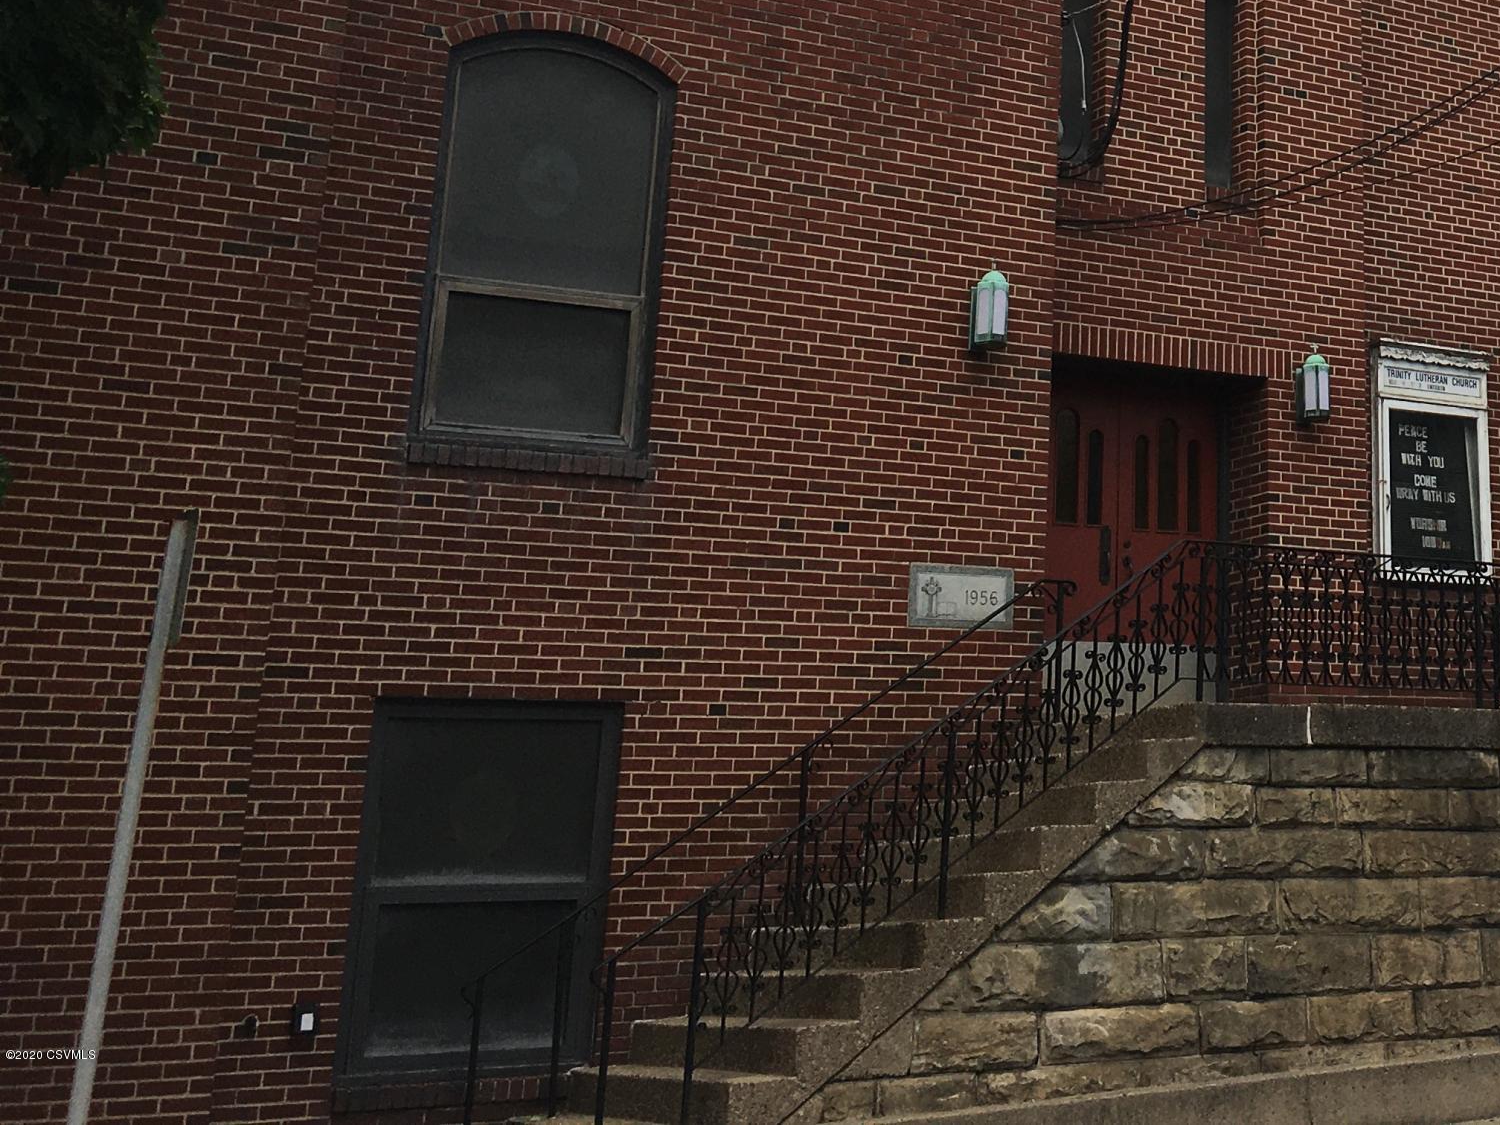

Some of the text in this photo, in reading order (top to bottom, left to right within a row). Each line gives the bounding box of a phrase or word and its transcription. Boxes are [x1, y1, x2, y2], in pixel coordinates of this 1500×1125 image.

[1387, 368, 1412, 380] TRINITY
[1415, 371, 1448, 385] LUTHERAN
[1452, 377, 1478, 389] CHURCH
[1398, 424, 1428, 438] PEACE
[1415, 440, 1428, 453] BE
[1401, 452, 1445, 469] WITH YOU
[1413, 474, 1437, 488] COME
[1422, 488, 1443, 503] WITH
[1443, 491, 1456, 504] US
[964, 589, 999, 606] 1956
